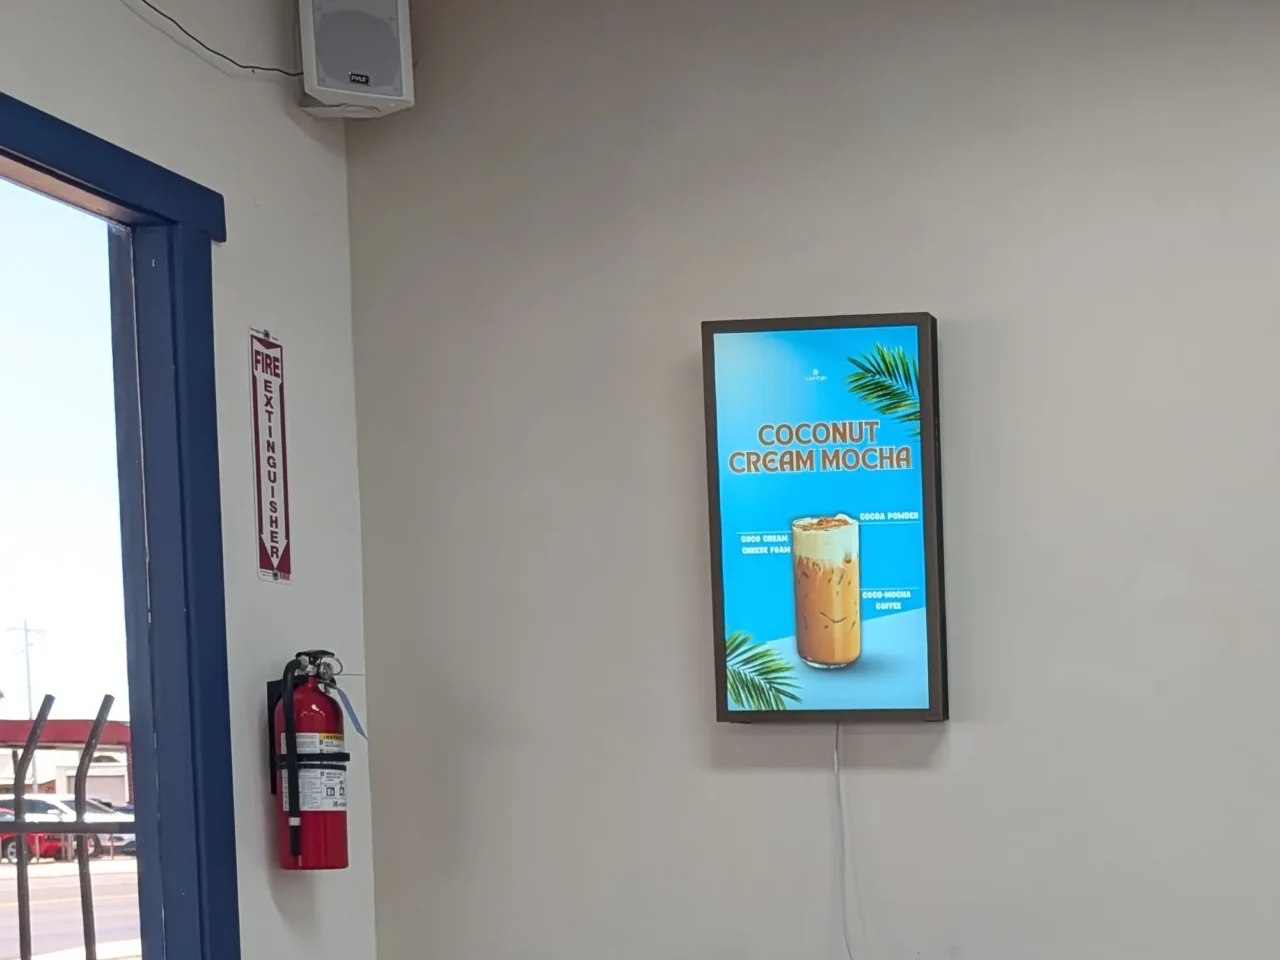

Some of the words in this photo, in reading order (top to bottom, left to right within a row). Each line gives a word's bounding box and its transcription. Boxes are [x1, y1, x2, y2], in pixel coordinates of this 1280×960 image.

[254, 349, 281, 379] FIRE
[757, 420, 880, 446] COCONUT
[728, 450, 815, 474] CREAM
[820, 446, 913, 472] MOCHA
[263, 379, 280, 559] EXTINGUISHER
[860, 512, 885, 521] COCOA
[887, 511, 919, 520] POWDER
[741, 535, 761, 543] COCO
[763, 534, 788, 543] CREAM
[742, 547, 768, 555] CHEESE
[770, 546, 791, 554] FOAM
[862, 591, 911, 599] COCO-MOCHA
[875, 602, 902, 610] COFFEE
